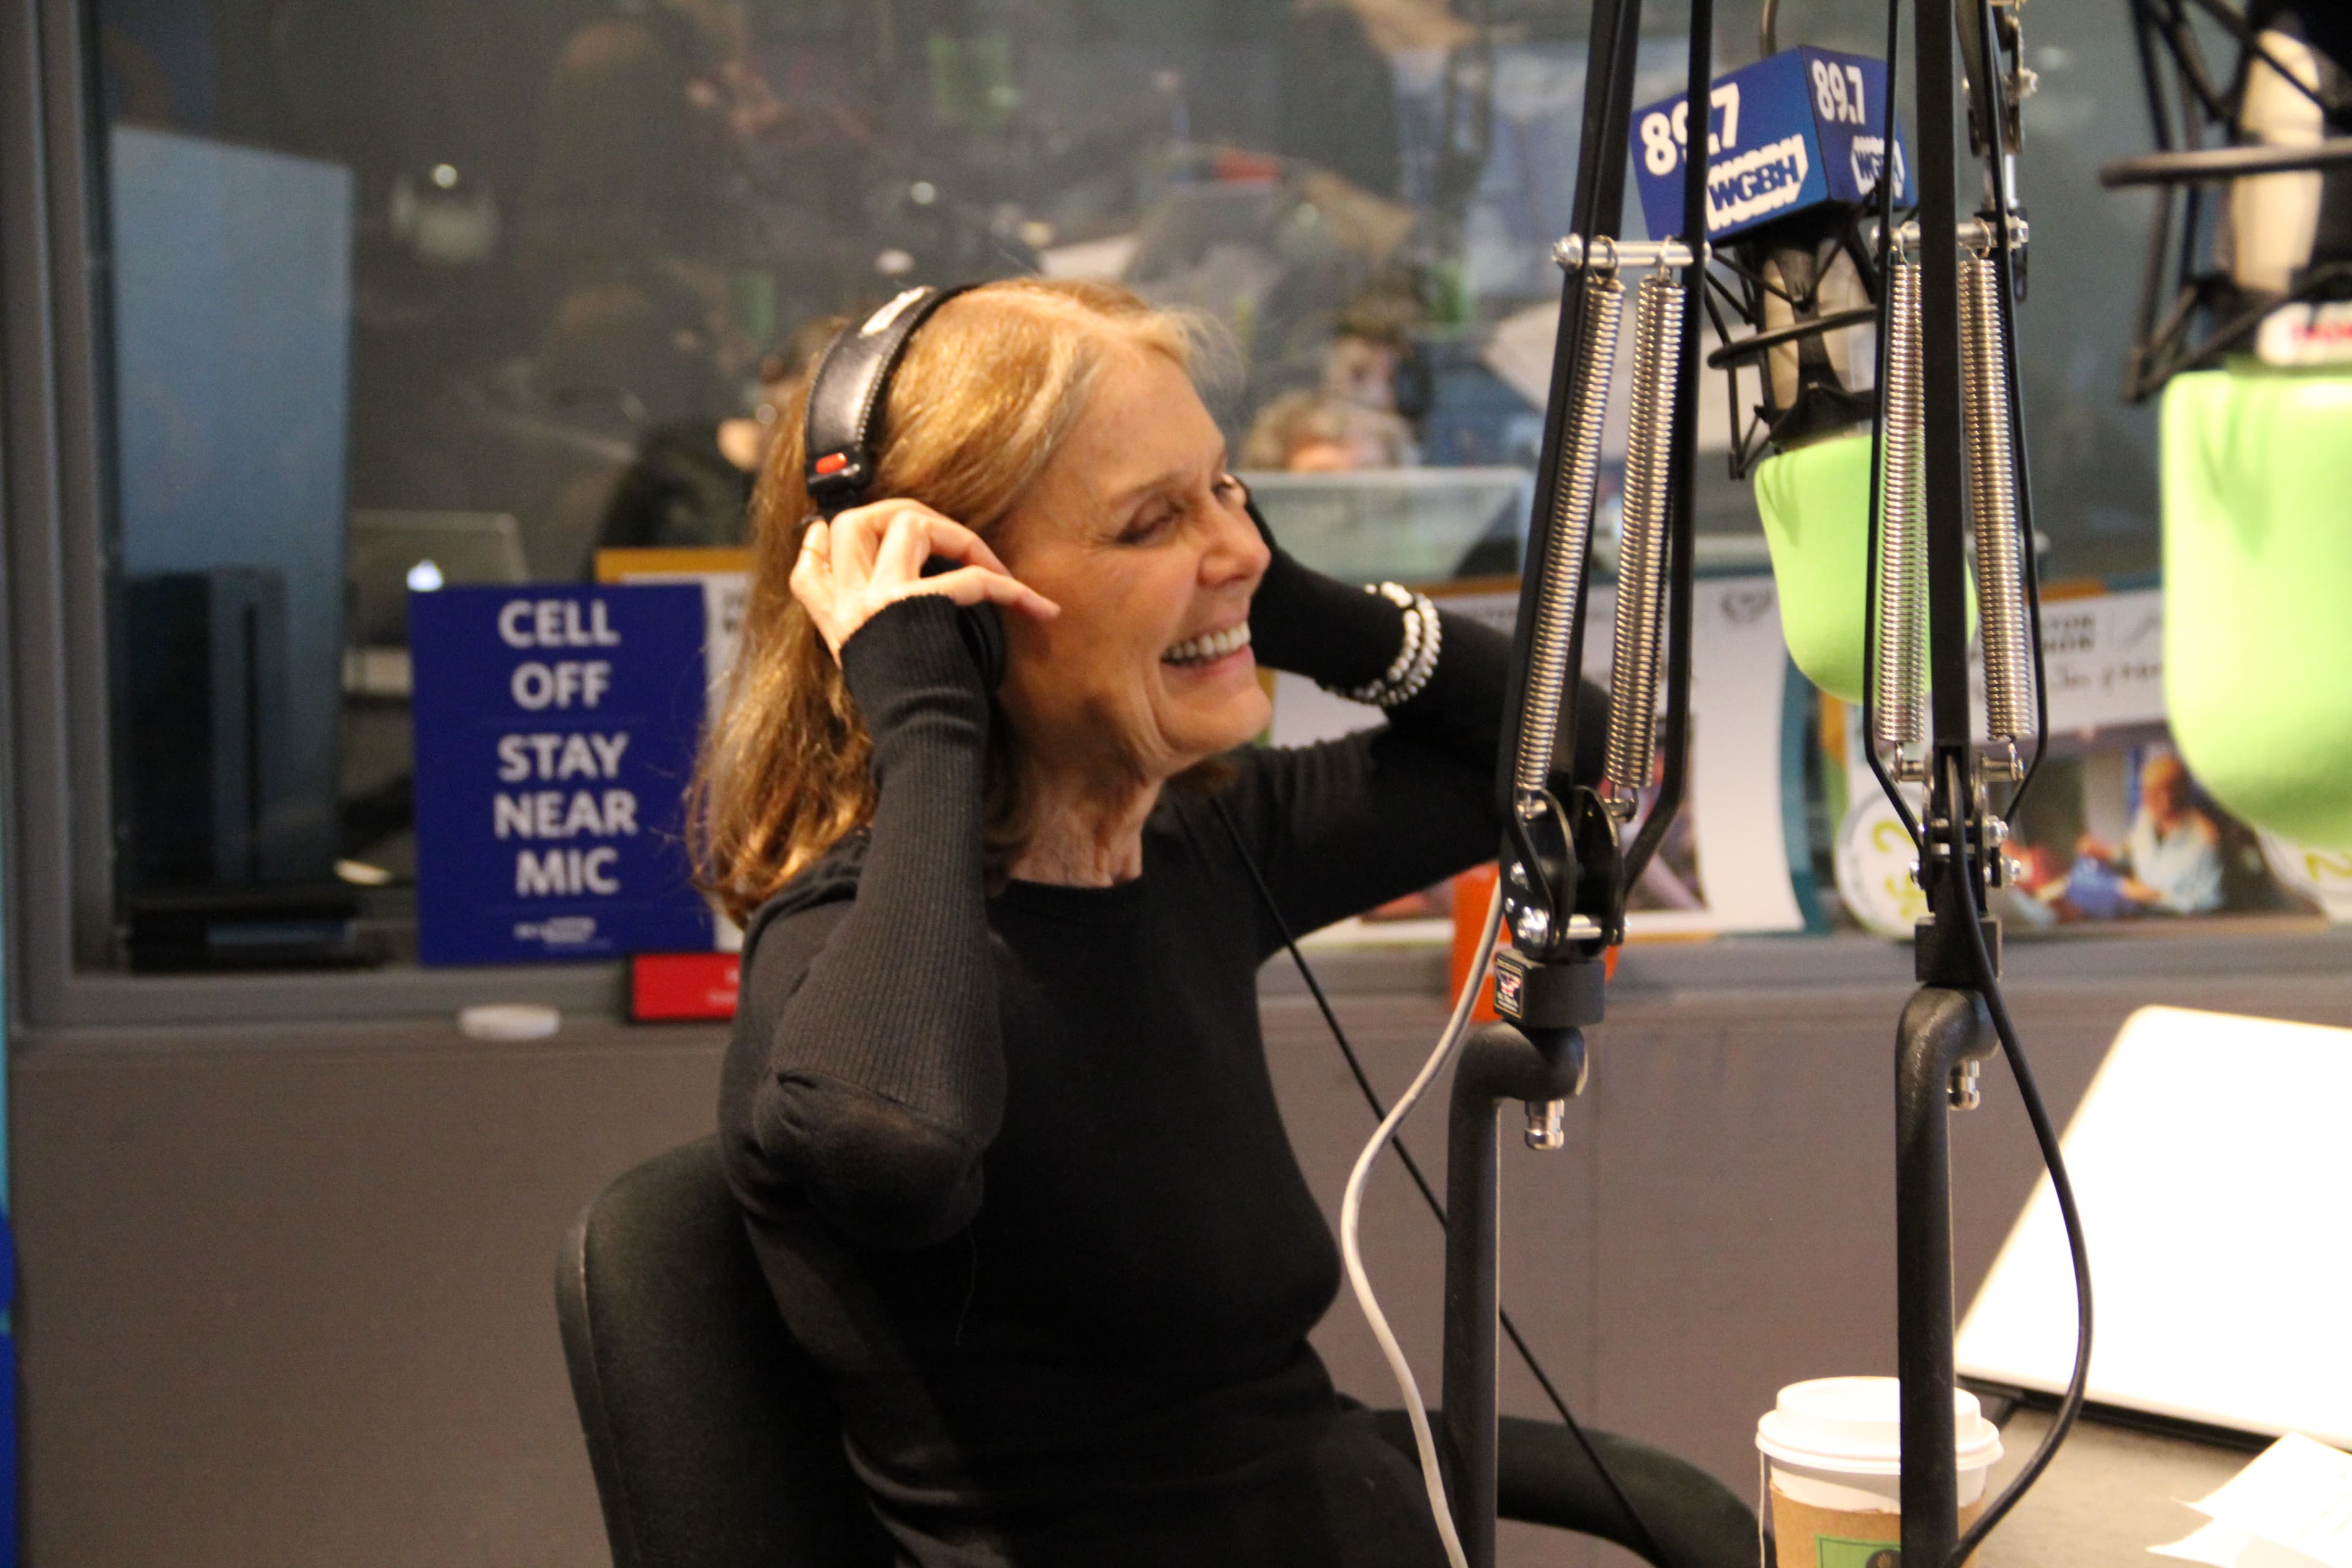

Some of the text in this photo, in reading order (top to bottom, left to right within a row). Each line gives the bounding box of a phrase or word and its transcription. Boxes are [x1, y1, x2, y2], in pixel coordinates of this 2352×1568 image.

[1812, 59, 1866, 124] 89.7
[1706, 138, 1808, 225] WGBH
[1852, 138, 1905, 195] WGH
[497, 600, 620, 647] CELL
[511, 660, 610, 709] OFF
[497, 733, 628, 781] STAY
[494, 789, 638, 839] NEAR
[515, 846, 619, 895] MIC
